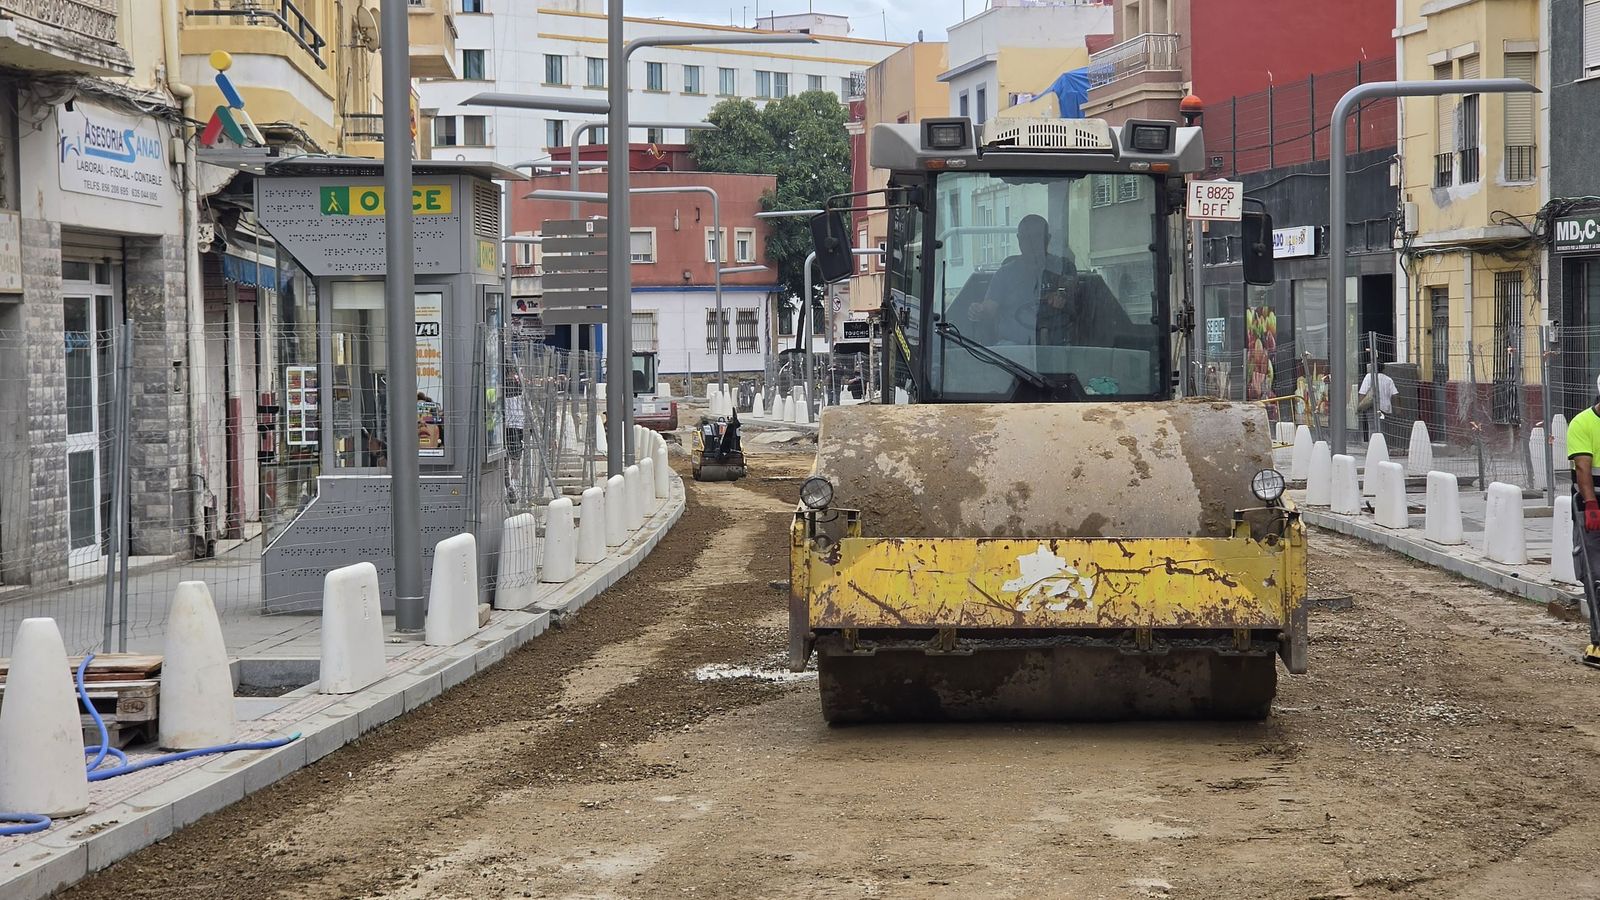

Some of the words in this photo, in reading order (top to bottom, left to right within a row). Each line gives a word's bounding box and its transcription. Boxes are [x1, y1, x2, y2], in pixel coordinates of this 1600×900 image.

[84, 118, 124, 151] ASESORIA
[123, 129, 160, 163] SANAD
[77, 160, 105, 175] LABORAL
[109, 166, 130, 180] FISCAL
[134, 171, 162, 186] CONTABLE
[360, 190, 441, 211] OCE
[1196, 186, 1203, 198] E
[1207, 187, 1234, 200] 8825
[1202, 203, 1228, 216] BFF
[1556, 219, 1596, 242] MDyC
